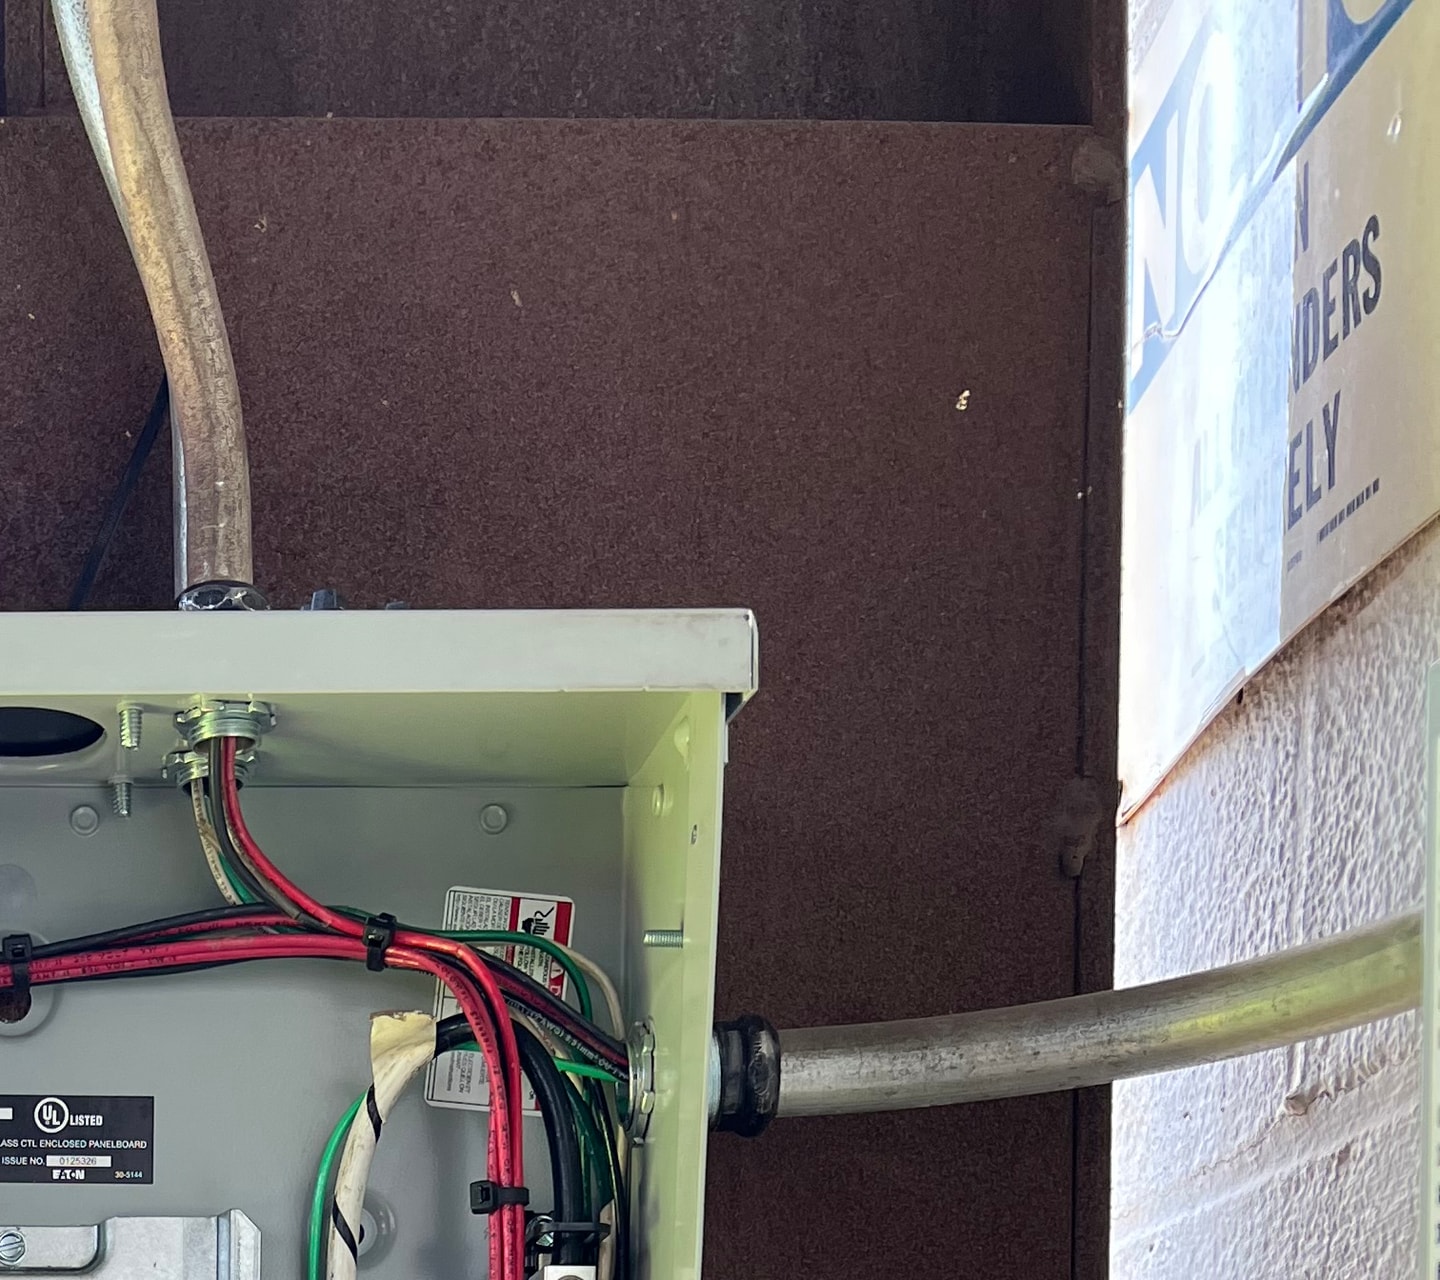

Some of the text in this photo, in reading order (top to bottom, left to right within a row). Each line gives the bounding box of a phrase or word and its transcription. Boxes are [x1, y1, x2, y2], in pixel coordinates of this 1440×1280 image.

[69, 1115, 104, 1126] LISTED
[20, 1139, 38, 1148] CTL
[39, 1139, 87, 1148] ENCLOSED
[88, 1139, 147, 1149] PANELBOARD
[1, 1156, 28, 1165] ISSUE
[29, 1156, 46, 1165] NO.
